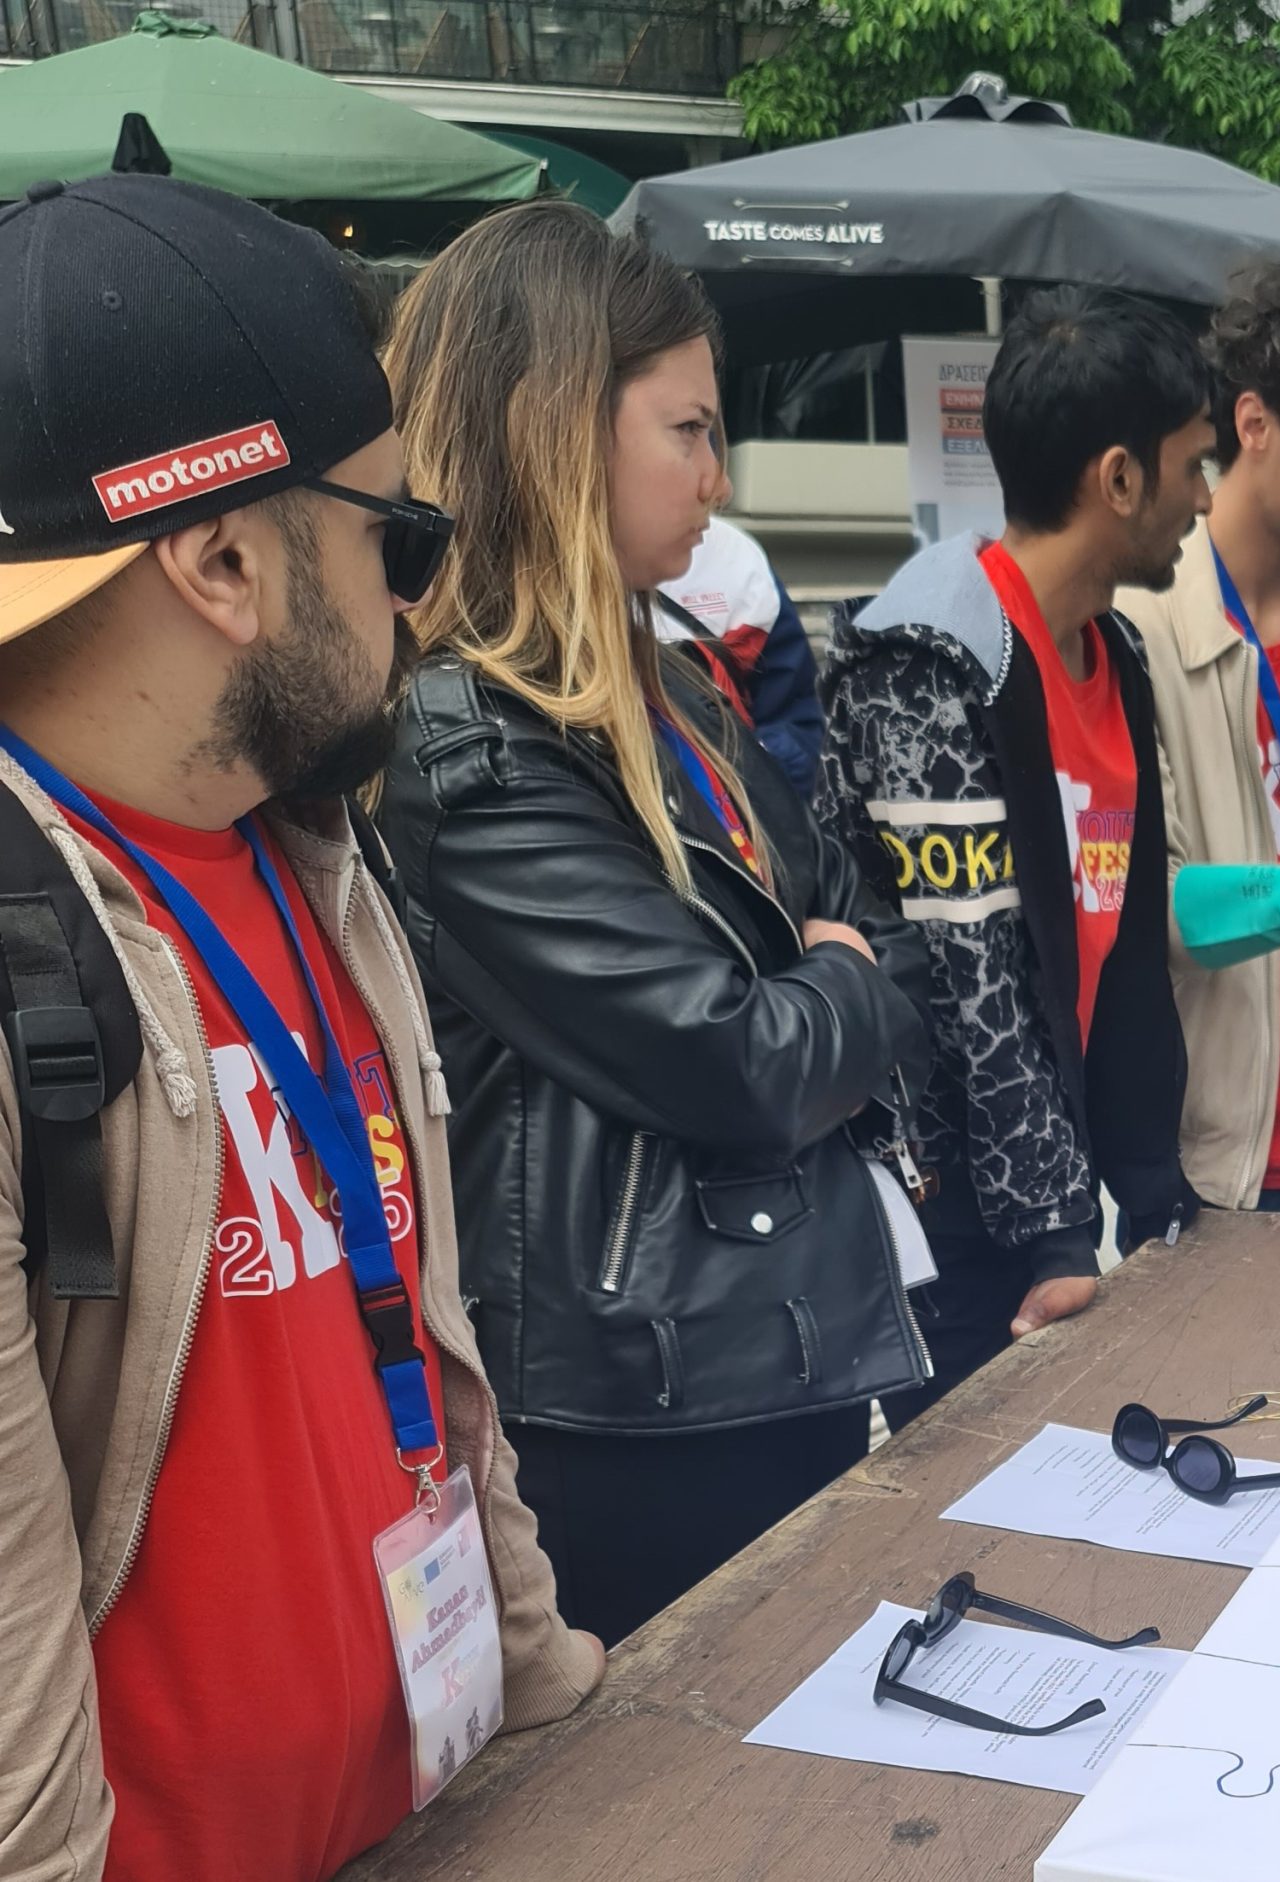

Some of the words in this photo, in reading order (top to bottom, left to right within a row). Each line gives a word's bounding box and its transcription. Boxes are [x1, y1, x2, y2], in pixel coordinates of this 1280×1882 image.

[704, 219, 767, 241] TASTE
[769, 225, 824, 242] COMES
[825, 222, 885, 244] ALIVE
[106, 429, 281, 508] motonet
[1081, 841, 1130, 882] FES
